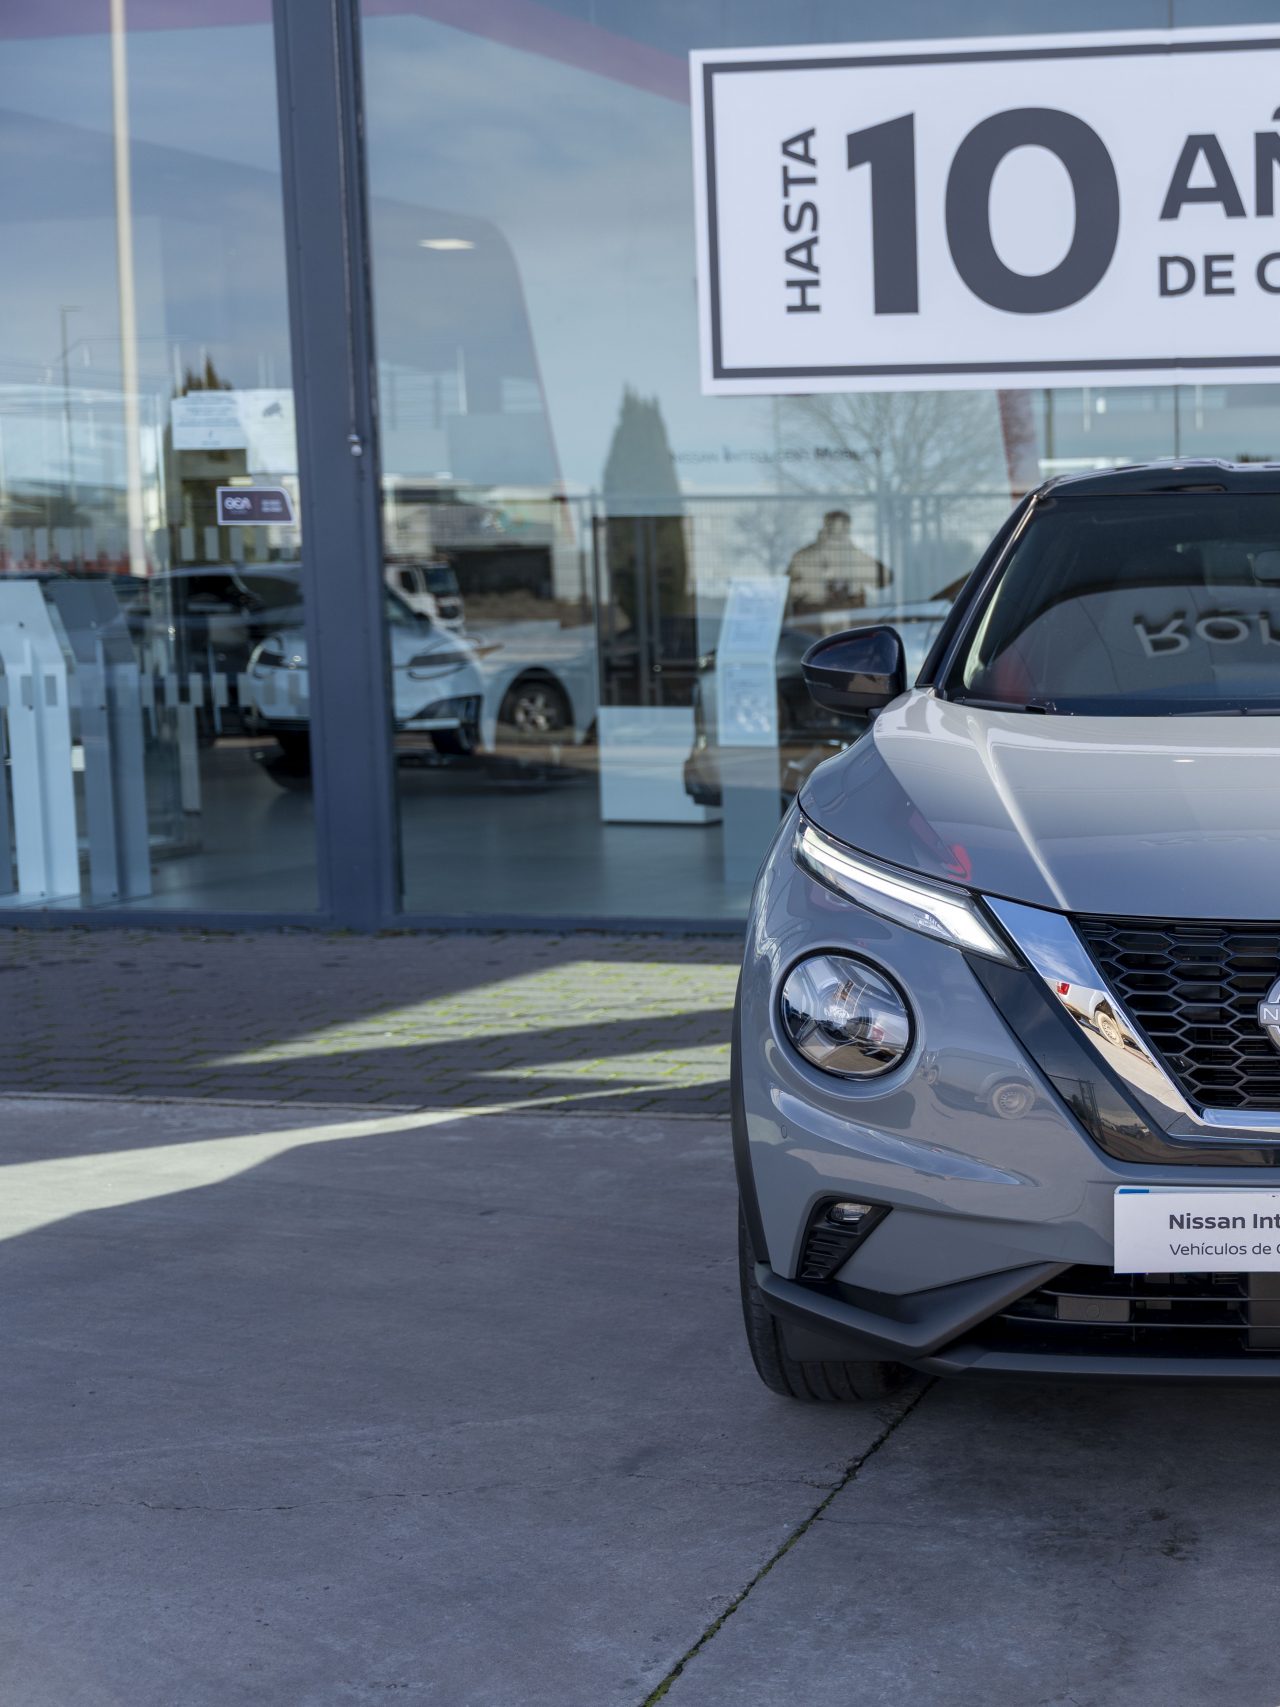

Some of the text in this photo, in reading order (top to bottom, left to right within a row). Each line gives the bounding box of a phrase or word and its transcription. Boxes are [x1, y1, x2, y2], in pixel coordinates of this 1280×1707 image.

[782, 127, 821, 313] HASTA
[846, 107, 1121, 315] 10
[1158, 254, 1236, 297] DE
[1169, 1212, 1246, 1230] Nissan
[1169, 1242, 1248, 1256] Vehículos
[1251, 1242, 1272, 1255] de
